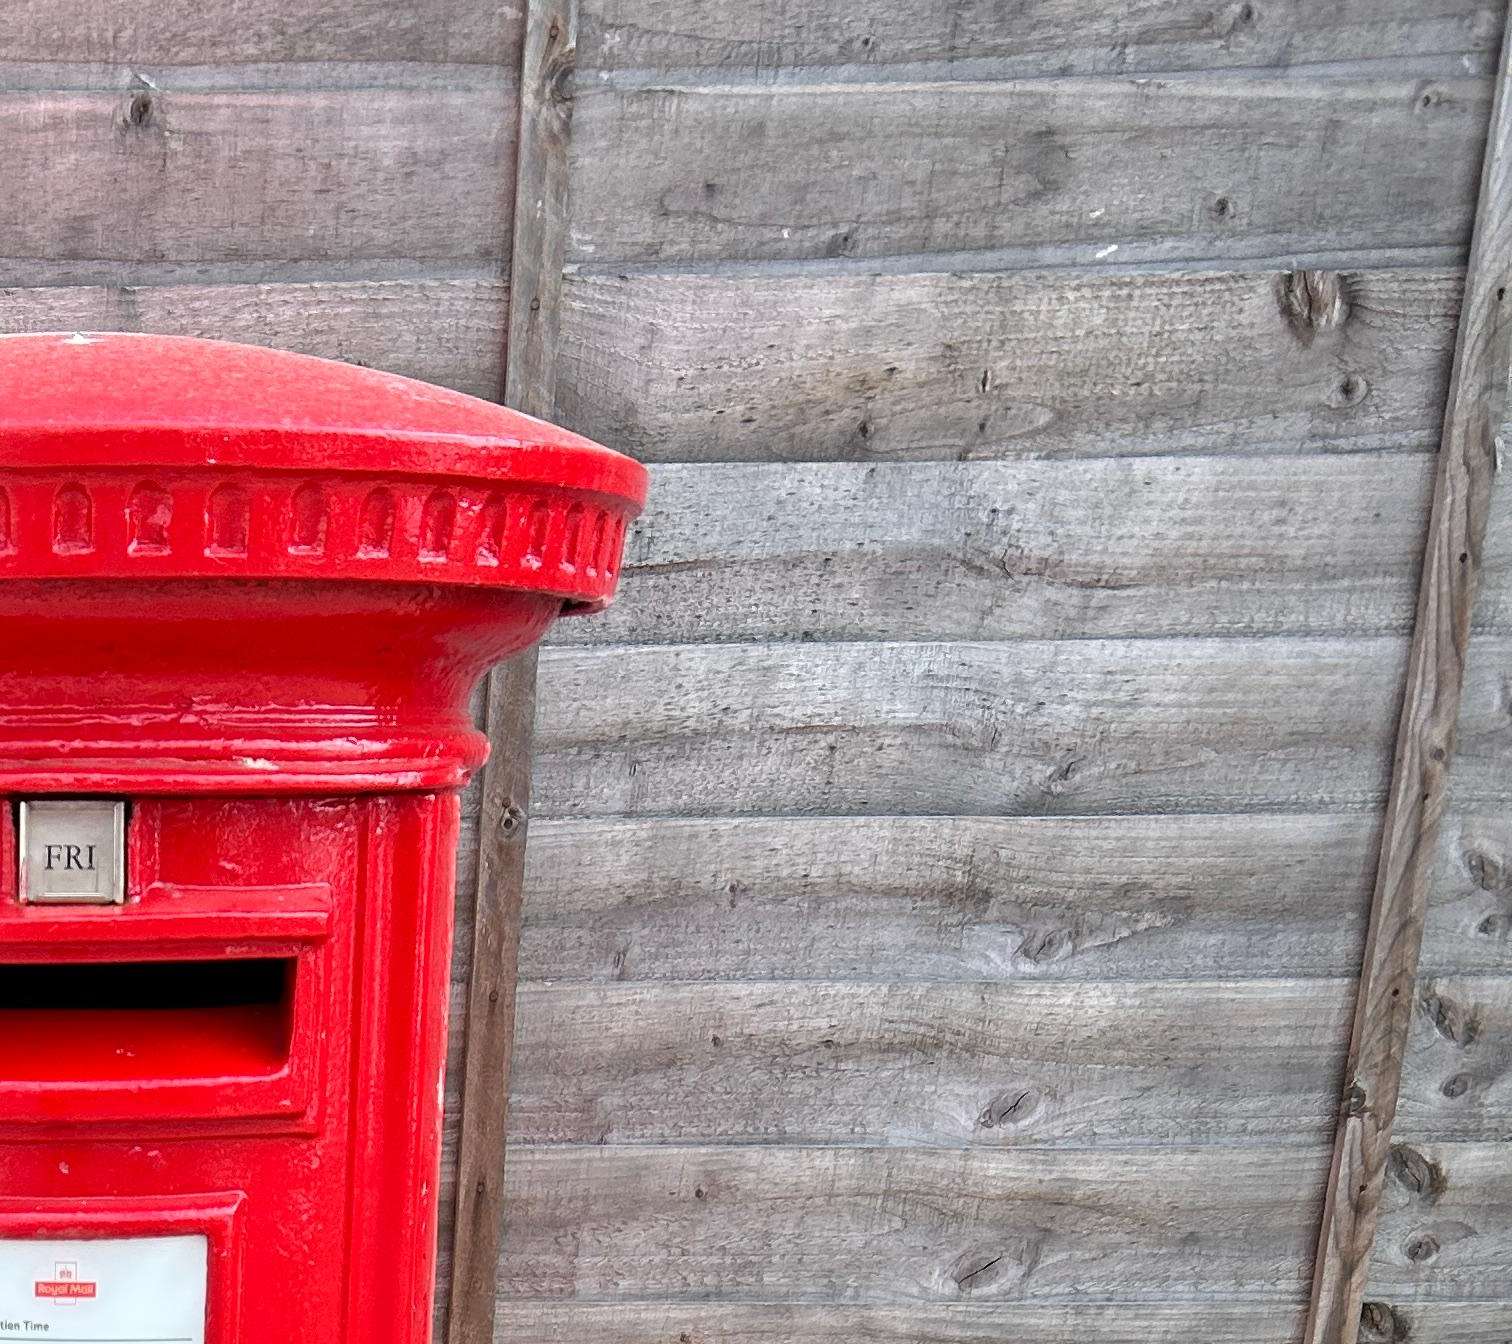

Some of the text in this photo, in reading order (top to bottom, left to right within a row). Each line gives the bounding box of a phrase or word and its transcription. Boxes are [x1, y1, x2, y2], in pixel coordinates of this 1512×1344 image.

[43, 844, 97, 871] FRI
[37, 1283, 94, 1296] Royal Mail
[23, 1321, 50, 1332] Time
